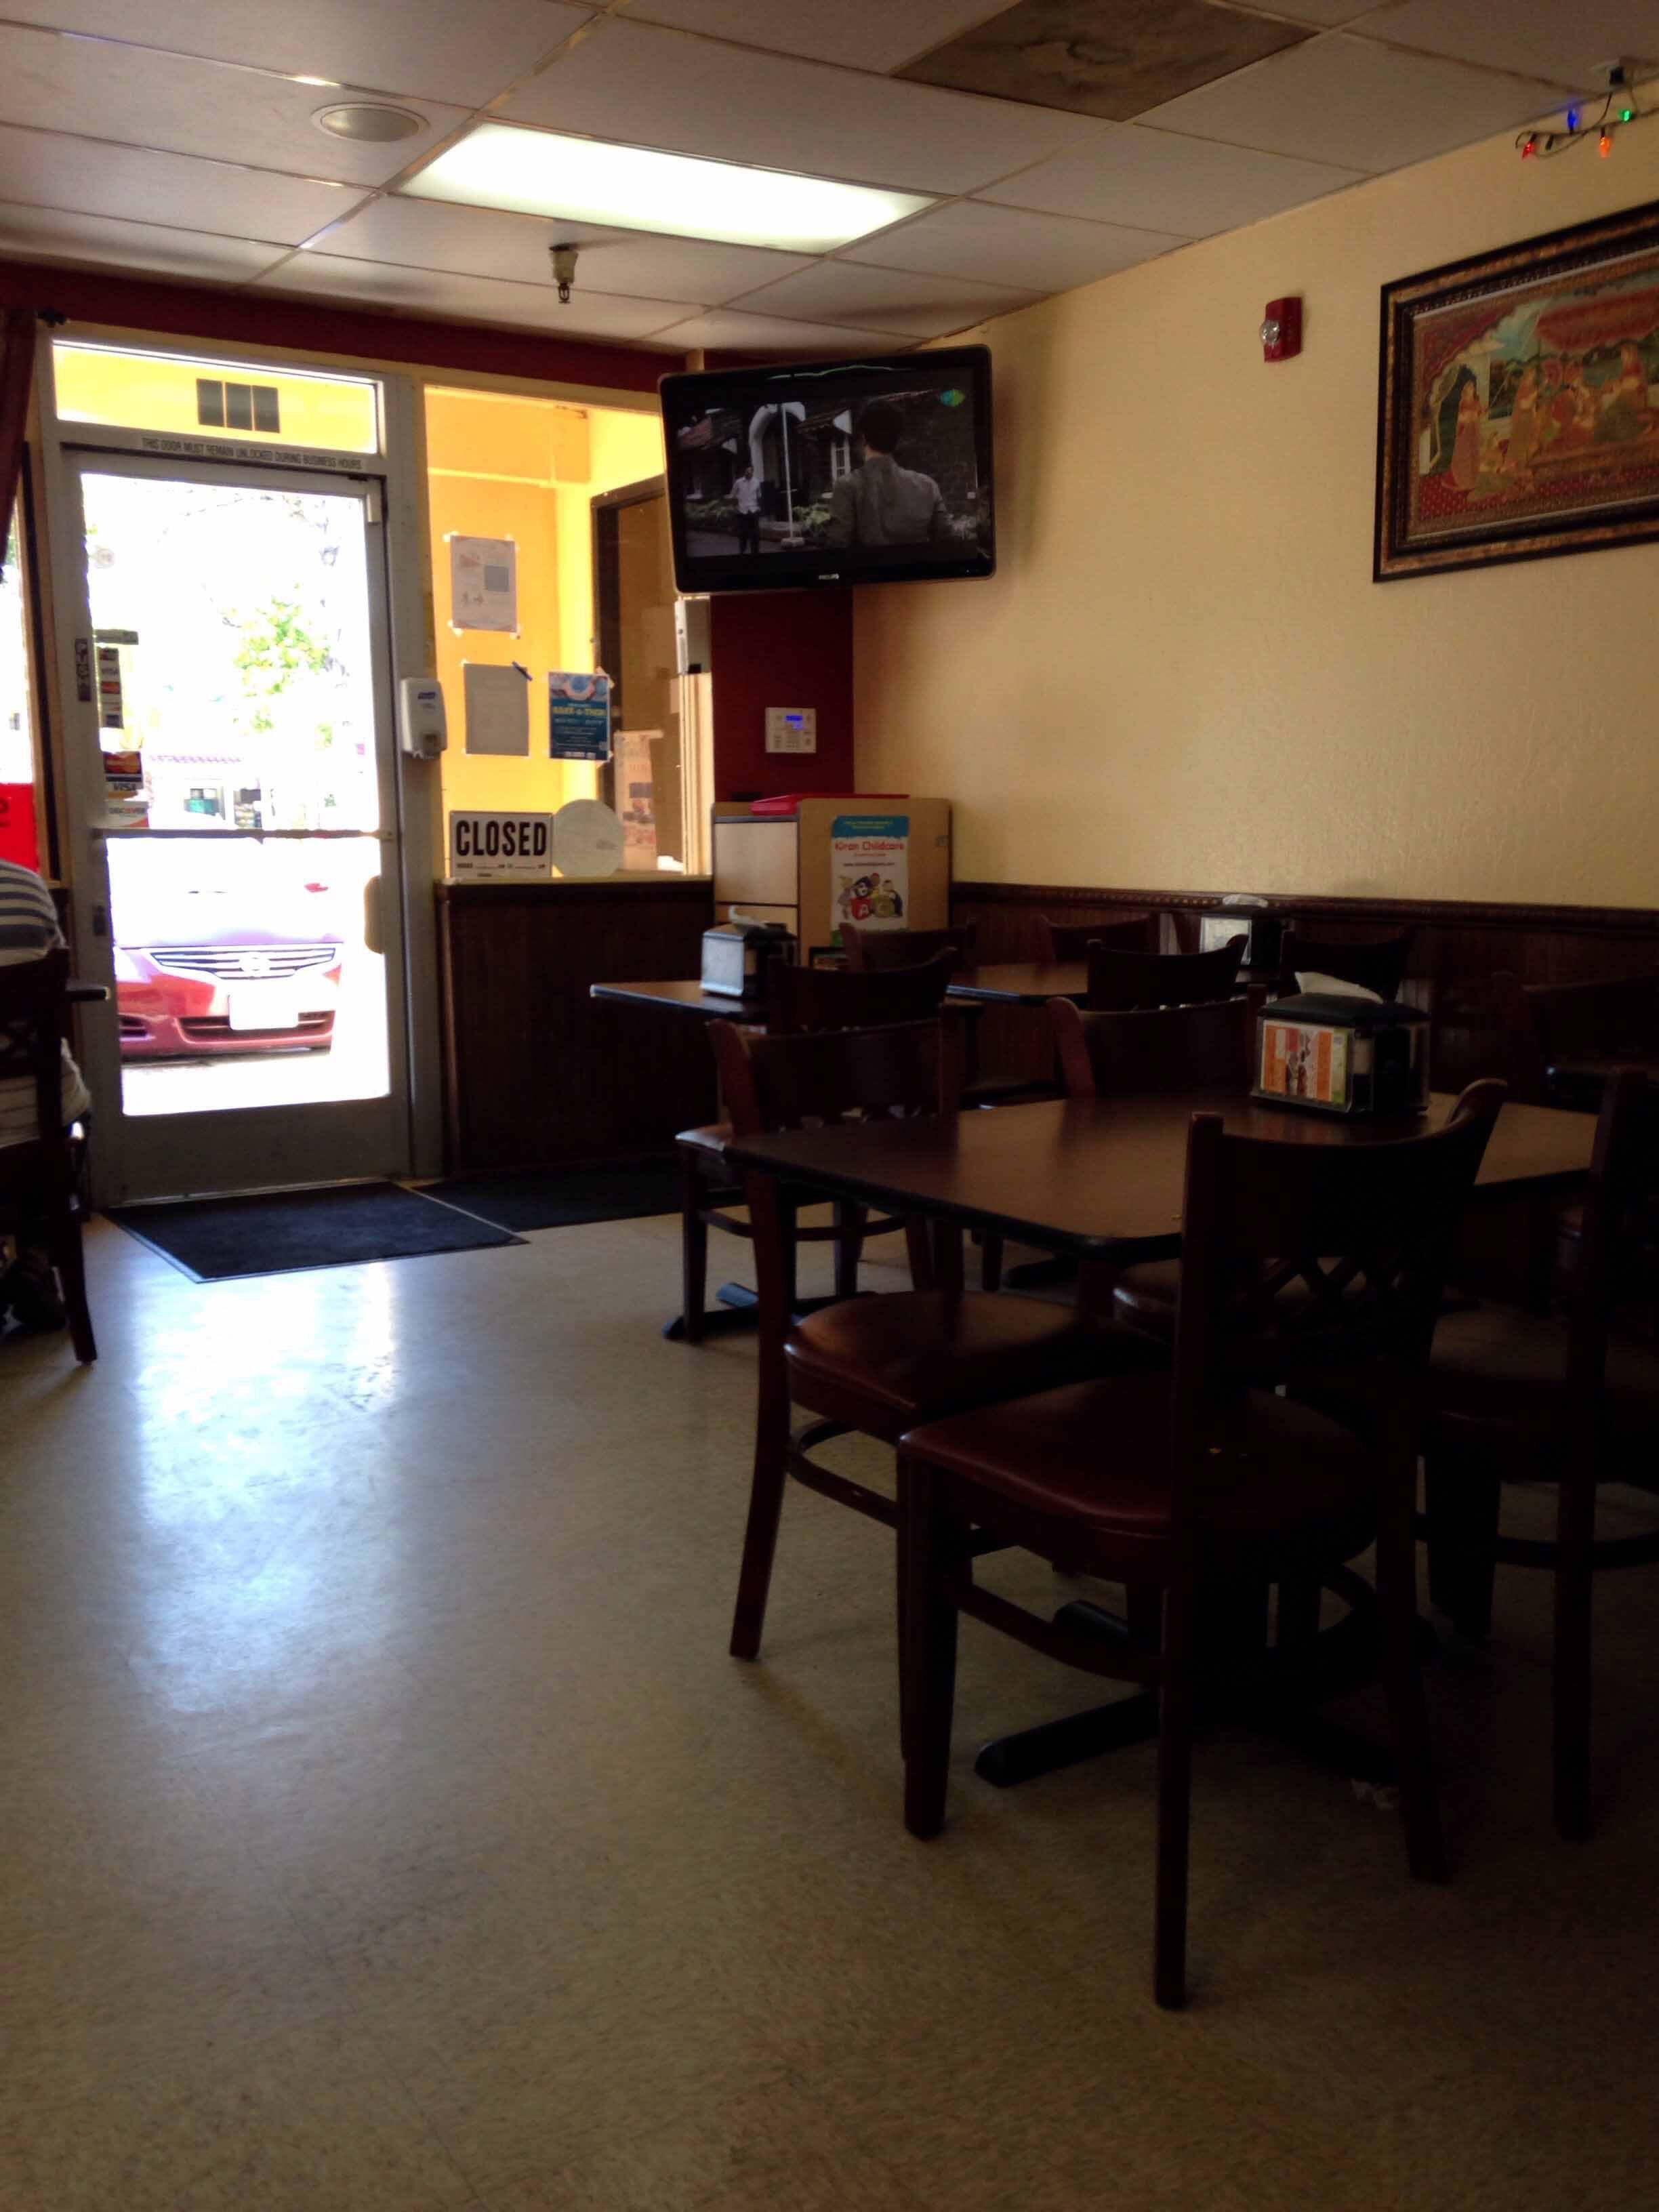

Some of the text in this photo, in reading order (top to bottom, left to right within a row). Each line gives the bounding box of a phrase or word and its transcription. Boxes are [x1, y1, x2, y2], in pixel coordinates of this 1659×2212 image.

[183, 442, 204, 454] MUST
[206, 444, 234, 457] REMAIN
[338, 458, 363, 470] HOURS
[112, 781, 138, 792] VISA
[456, 820, 547, 857] CLOSED
[862, 840, 904, 851] Childcare
